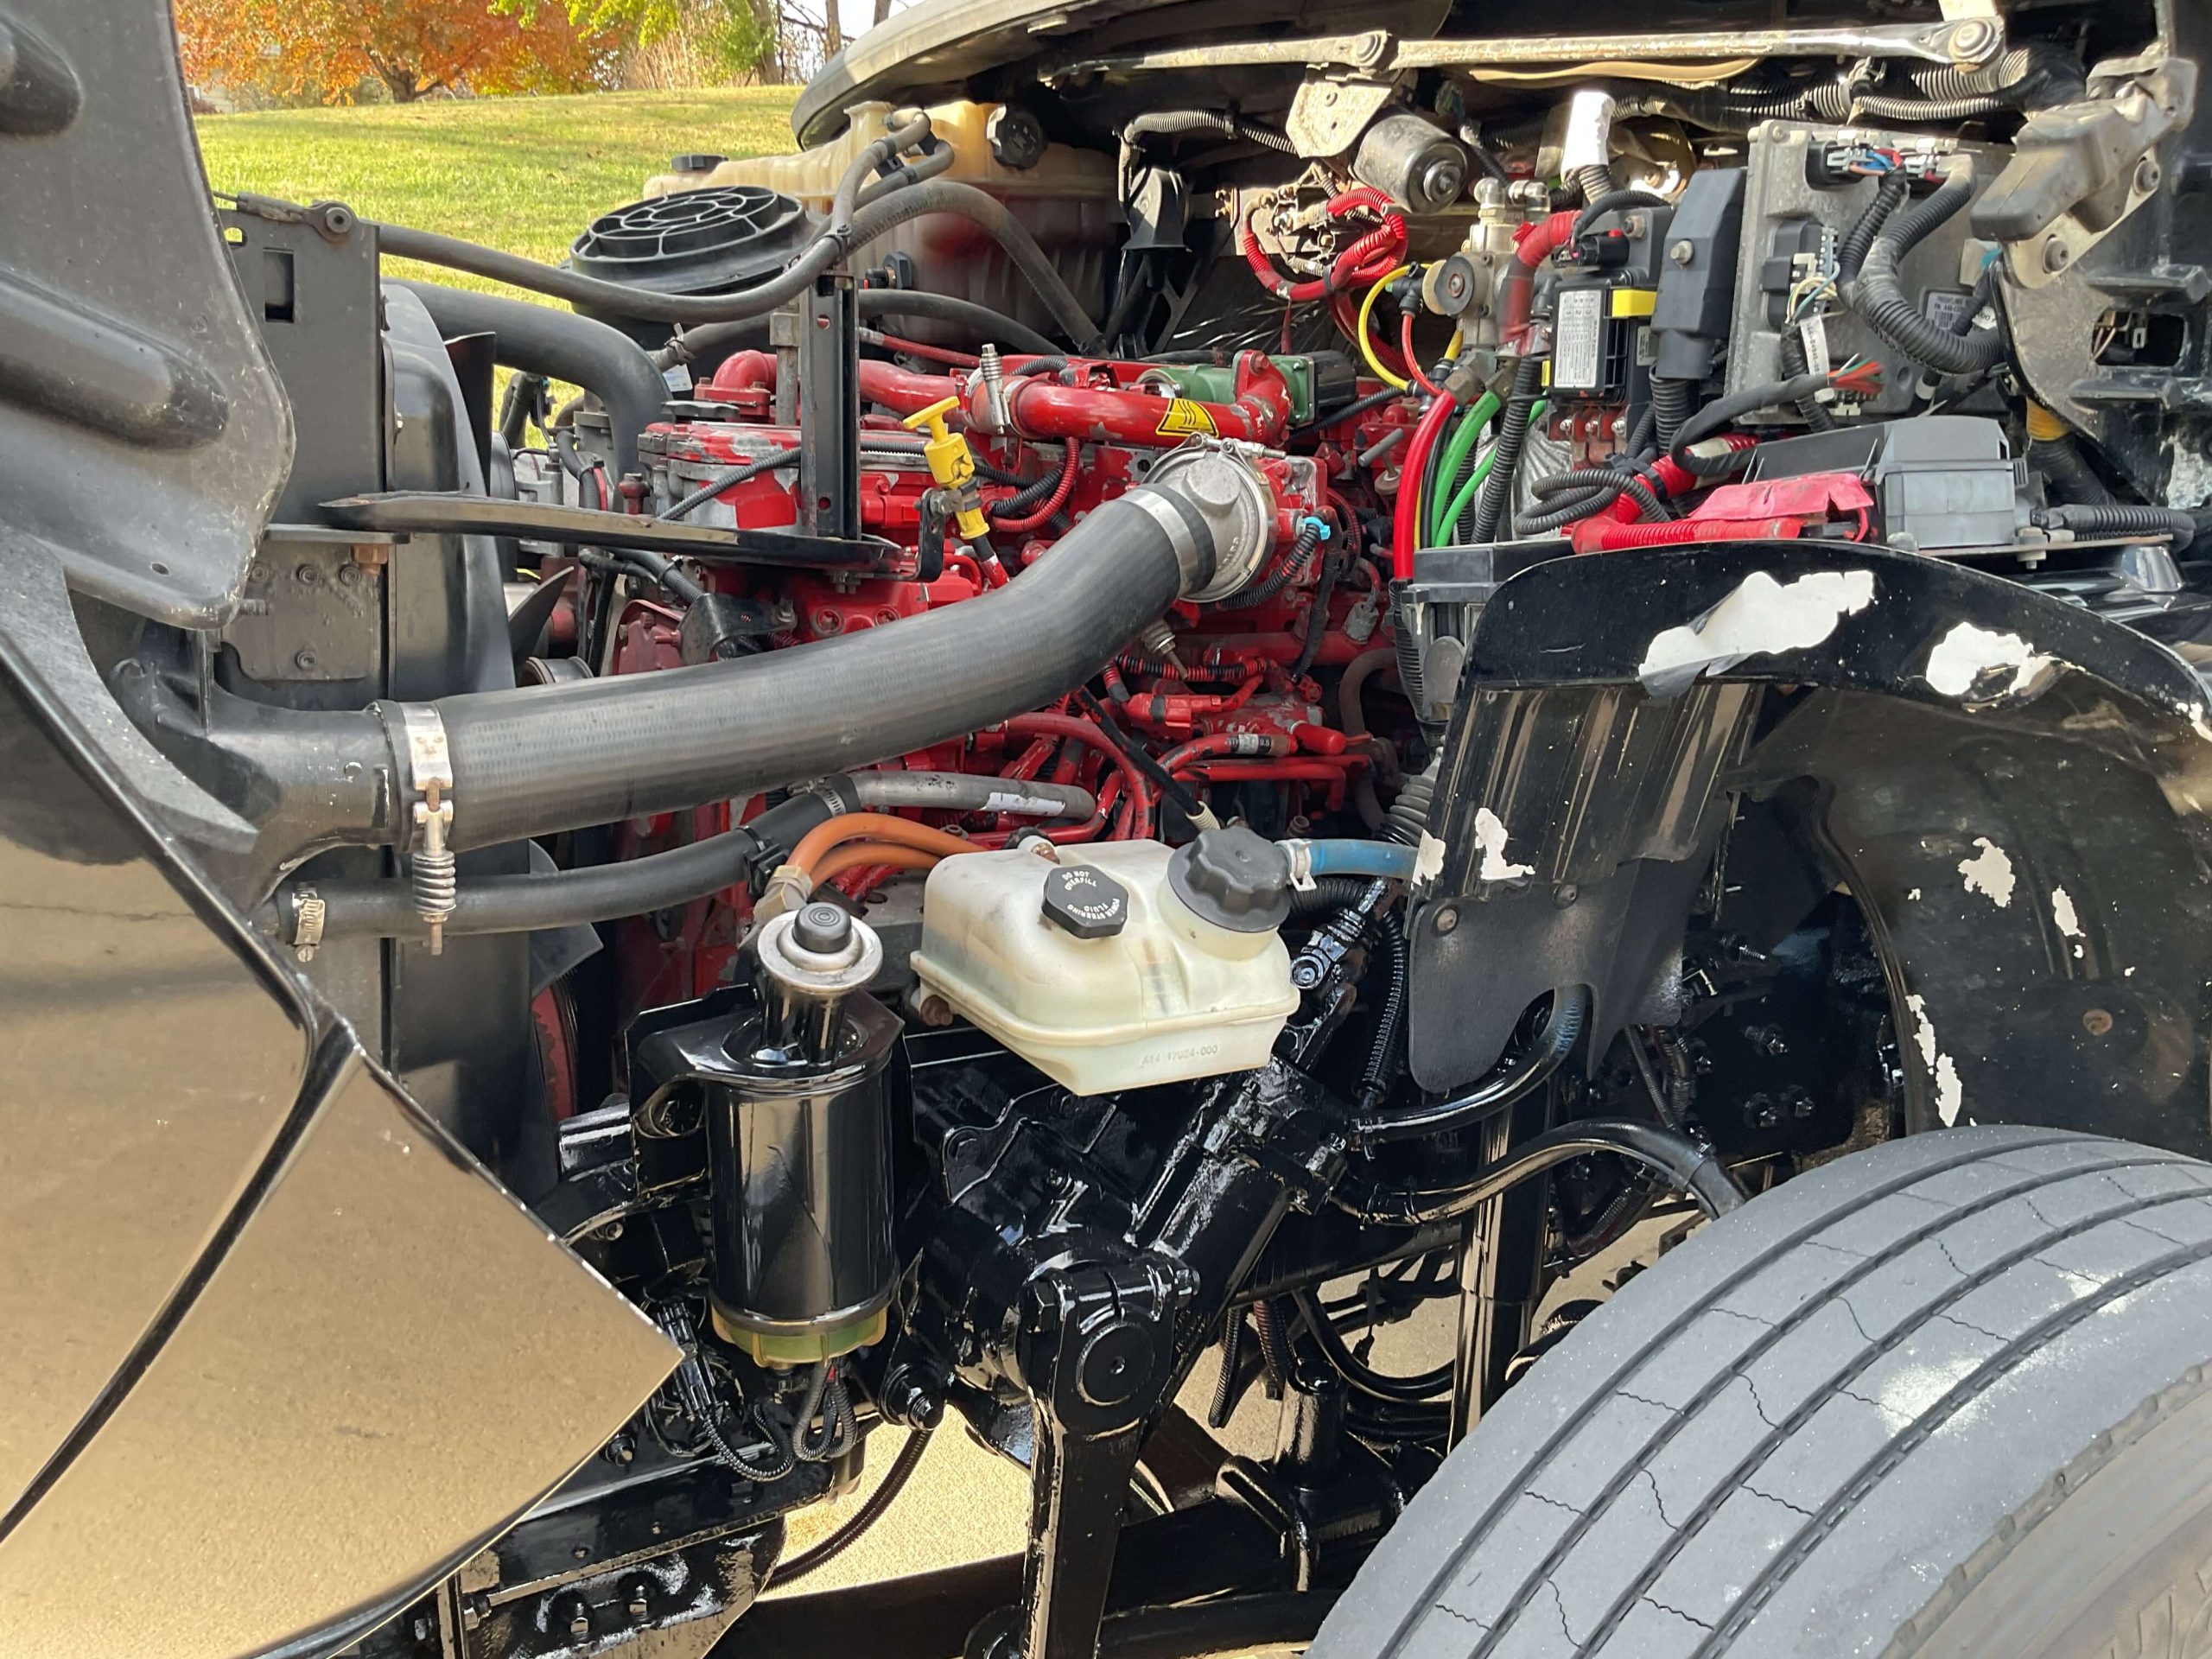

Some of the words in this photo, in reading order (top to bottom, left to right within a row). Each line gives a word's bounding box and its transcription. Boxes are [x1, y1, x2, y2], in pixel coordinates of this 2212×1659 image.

[1062, 872, 1073, 880] DO
[1065, 877, 1096, 891] OVERFILL
[1067, 904, 1106, 919] STEERING
[1084, 902, 1109, 913] FLUID
[1105, 898, 1120, 917] POWER
